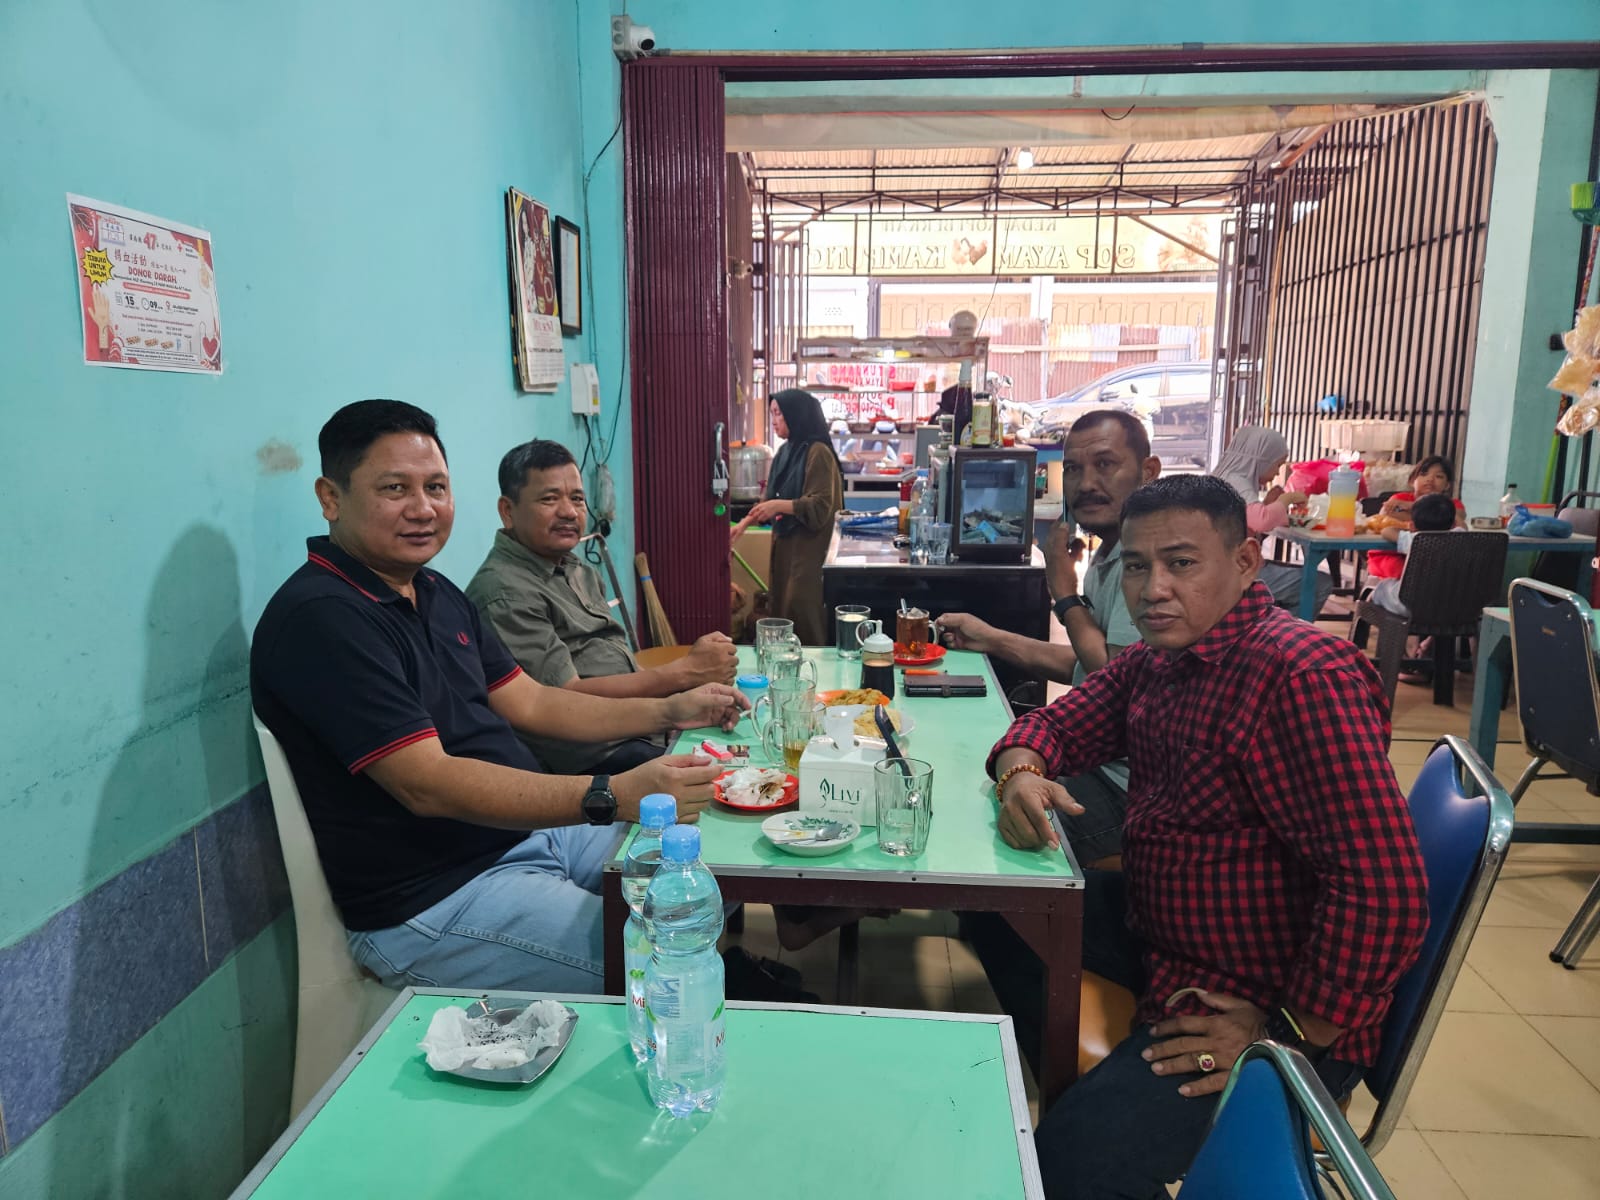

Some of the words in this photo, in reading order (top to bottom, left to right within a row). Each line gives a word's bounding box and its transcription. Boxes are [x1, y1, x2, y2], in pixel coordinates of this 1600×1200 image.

[143, 231, 157, 251] 47
[128, 266, 152, 279] DONOR
[154, 271, 177, 284] DARAH
[125, 295, 135, 305] 15
